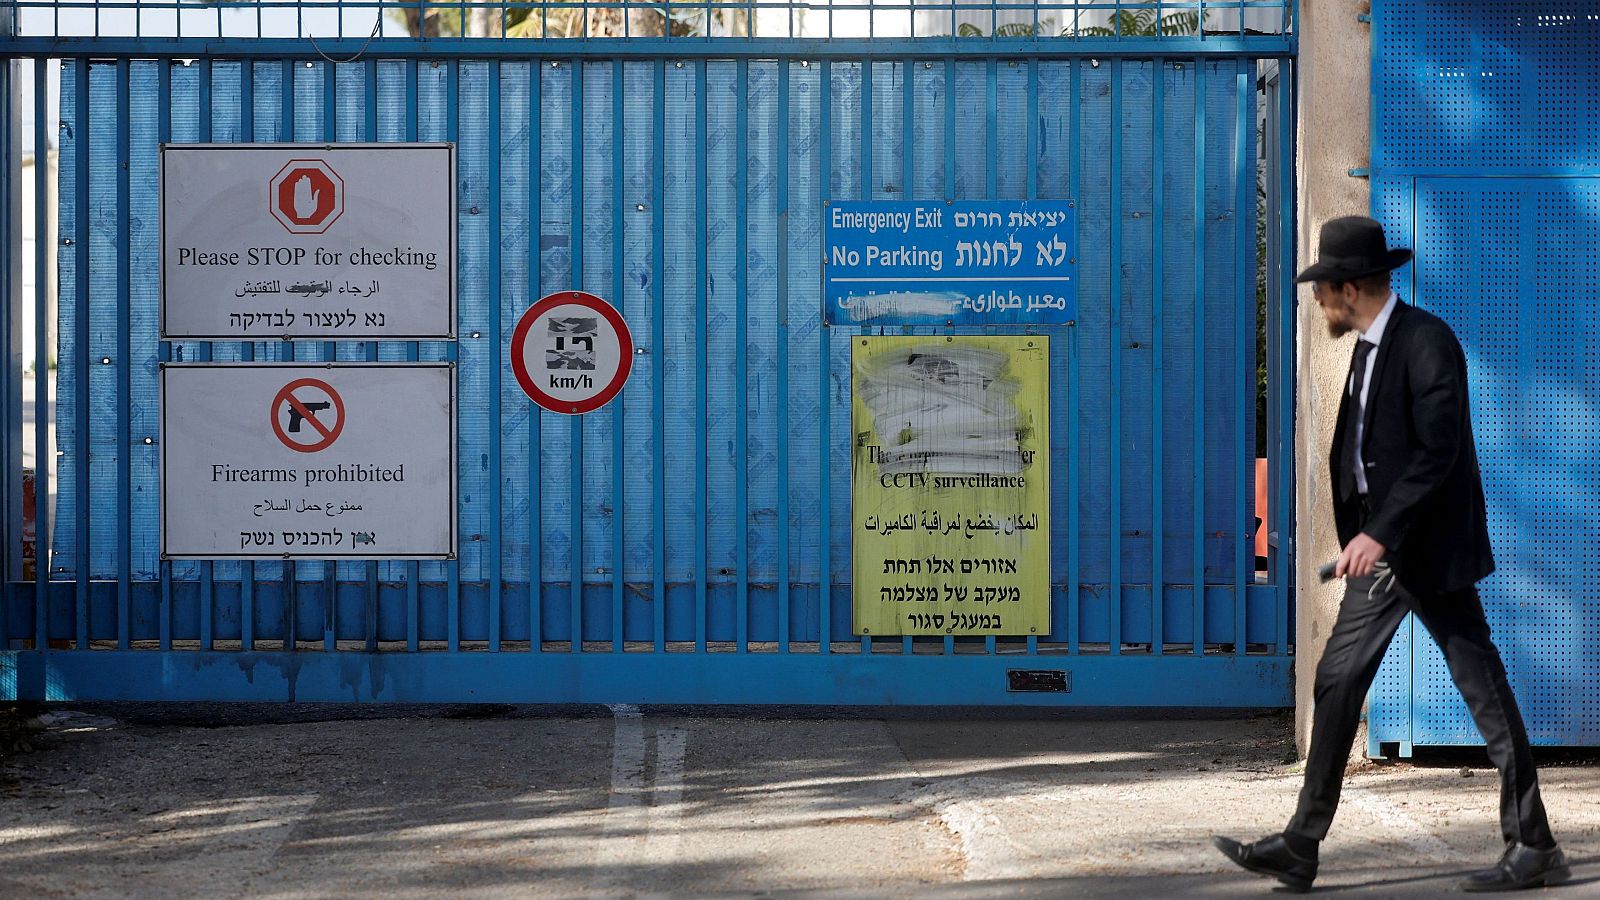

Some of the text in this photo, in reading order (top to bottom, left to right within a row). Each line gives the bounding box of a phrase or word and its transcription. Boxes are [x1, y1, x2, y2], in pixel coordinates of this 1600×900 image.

[833, 208, 942, 232] Emergency Exit
[954, 211, 1066, 228] יציאת חרום
[178, 248, 437, 270] Please STOP for checking
[832, 245, 943, 271] No Parking
[955, 233, 1067, 267] לא לחנות
[235, 280, 281, 297] للتفتيش
[338, 280, 380, 297] الرجاء
[1026, 295, 1066, 312] معبر
[230, 309, 385, 331] נא לעצור לבדיקה
[550, 374, 592, 389] km/h
[212, 464, 404, 487] Firearms prohibited
[880, 473, 931, 488] CCTV
[254, 499, 362, 516] ممنوع حمل السلاح
[865, 513, 916, 536] الكاميرات
[921, 510, 961, 536] لمراقبة
[1004, 513, 1038, 535] المكان
[240, 530, 274, 550] נשק
[283, 528, 342, 546] להכניס
[883, 555, 1017, 574] אזורים אלו תחת
[880, 583, 1020, 606] מעקב של מצלמה
[908, 610, 1002, 629] במעגל סגור
